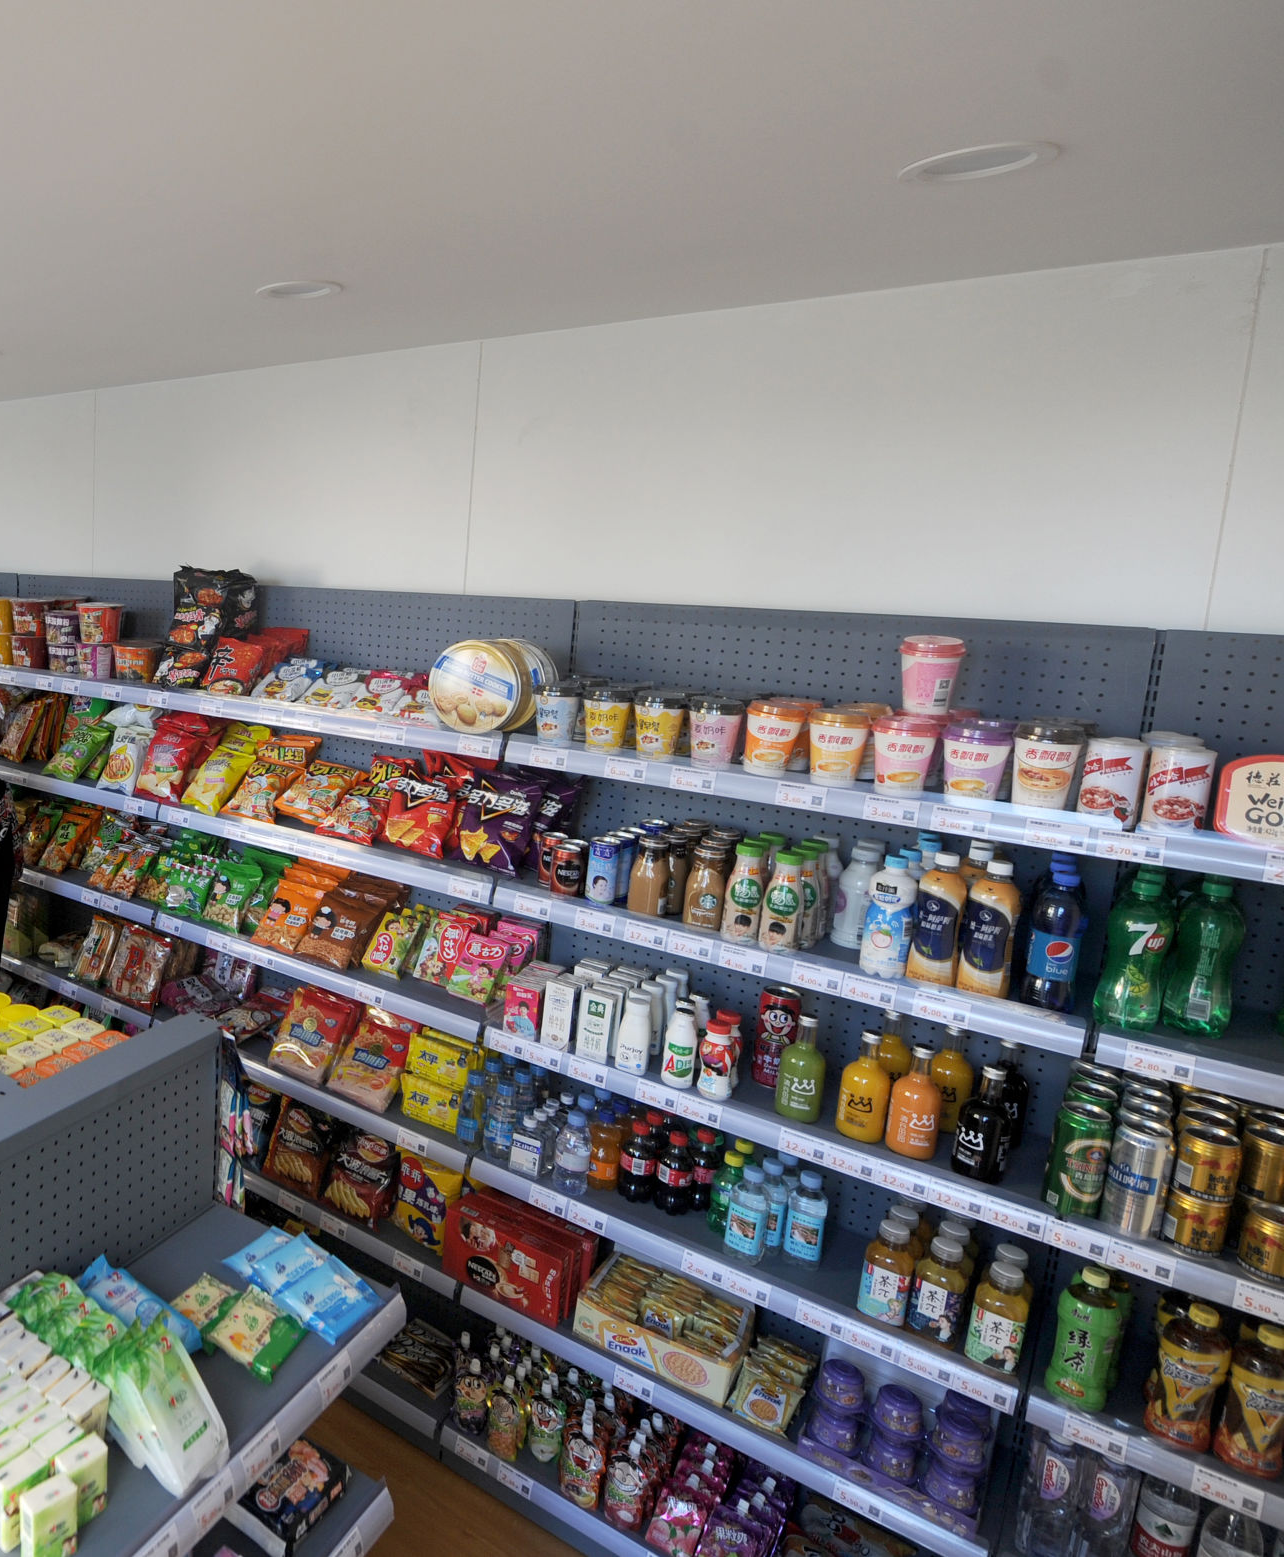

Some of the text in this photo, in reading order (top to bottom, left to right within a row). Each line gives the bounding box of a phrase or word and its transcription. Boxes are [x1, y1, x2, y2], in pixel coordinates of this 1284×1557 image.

[209, 645, 235, 679] 辛
[757, 725, 791, 736] 香飘飘
[818, 734, 853, 745] 香飘飘
[886, 742, 925, 753] 香飘飘
[950, 749, 989, 761] 香飘飘
[1025, 748, 1072, 762] 香飘飘
[370, 761, 403, 785] 呀!土
[395, 777, 449, 802] 多力多滋
[468, 789, 531, 816] 多力多滋
[871, 806, 891, 818] 3.60
[939, 818, 960, 829] 3.60
[1106, 845, 1131, 855] 3.70
[469, 942, 502, 957] 蘑古力
[1045, 964, 1069, 976] blue
[590, 1002, 605, 1015] 金典
[417, 1050, 439, 1065] 太平
[1134, 1058, 1160, 1071] 2.80
[407, 1090, 430, 1106] 太平
[994, 1212, 1018, 1227] 12.0
[1054, 1233, 1076, 1247] 5.50
[1117, 1255, 1141, 1270] 3.90
[1245, 1296, 1271, 1313] 5.50
[608, 1340, 646, 1358] Enaak
[1065, 1328, 1091, 1372] 绿茶
[961, 1381, 982, 1397] 5.00
